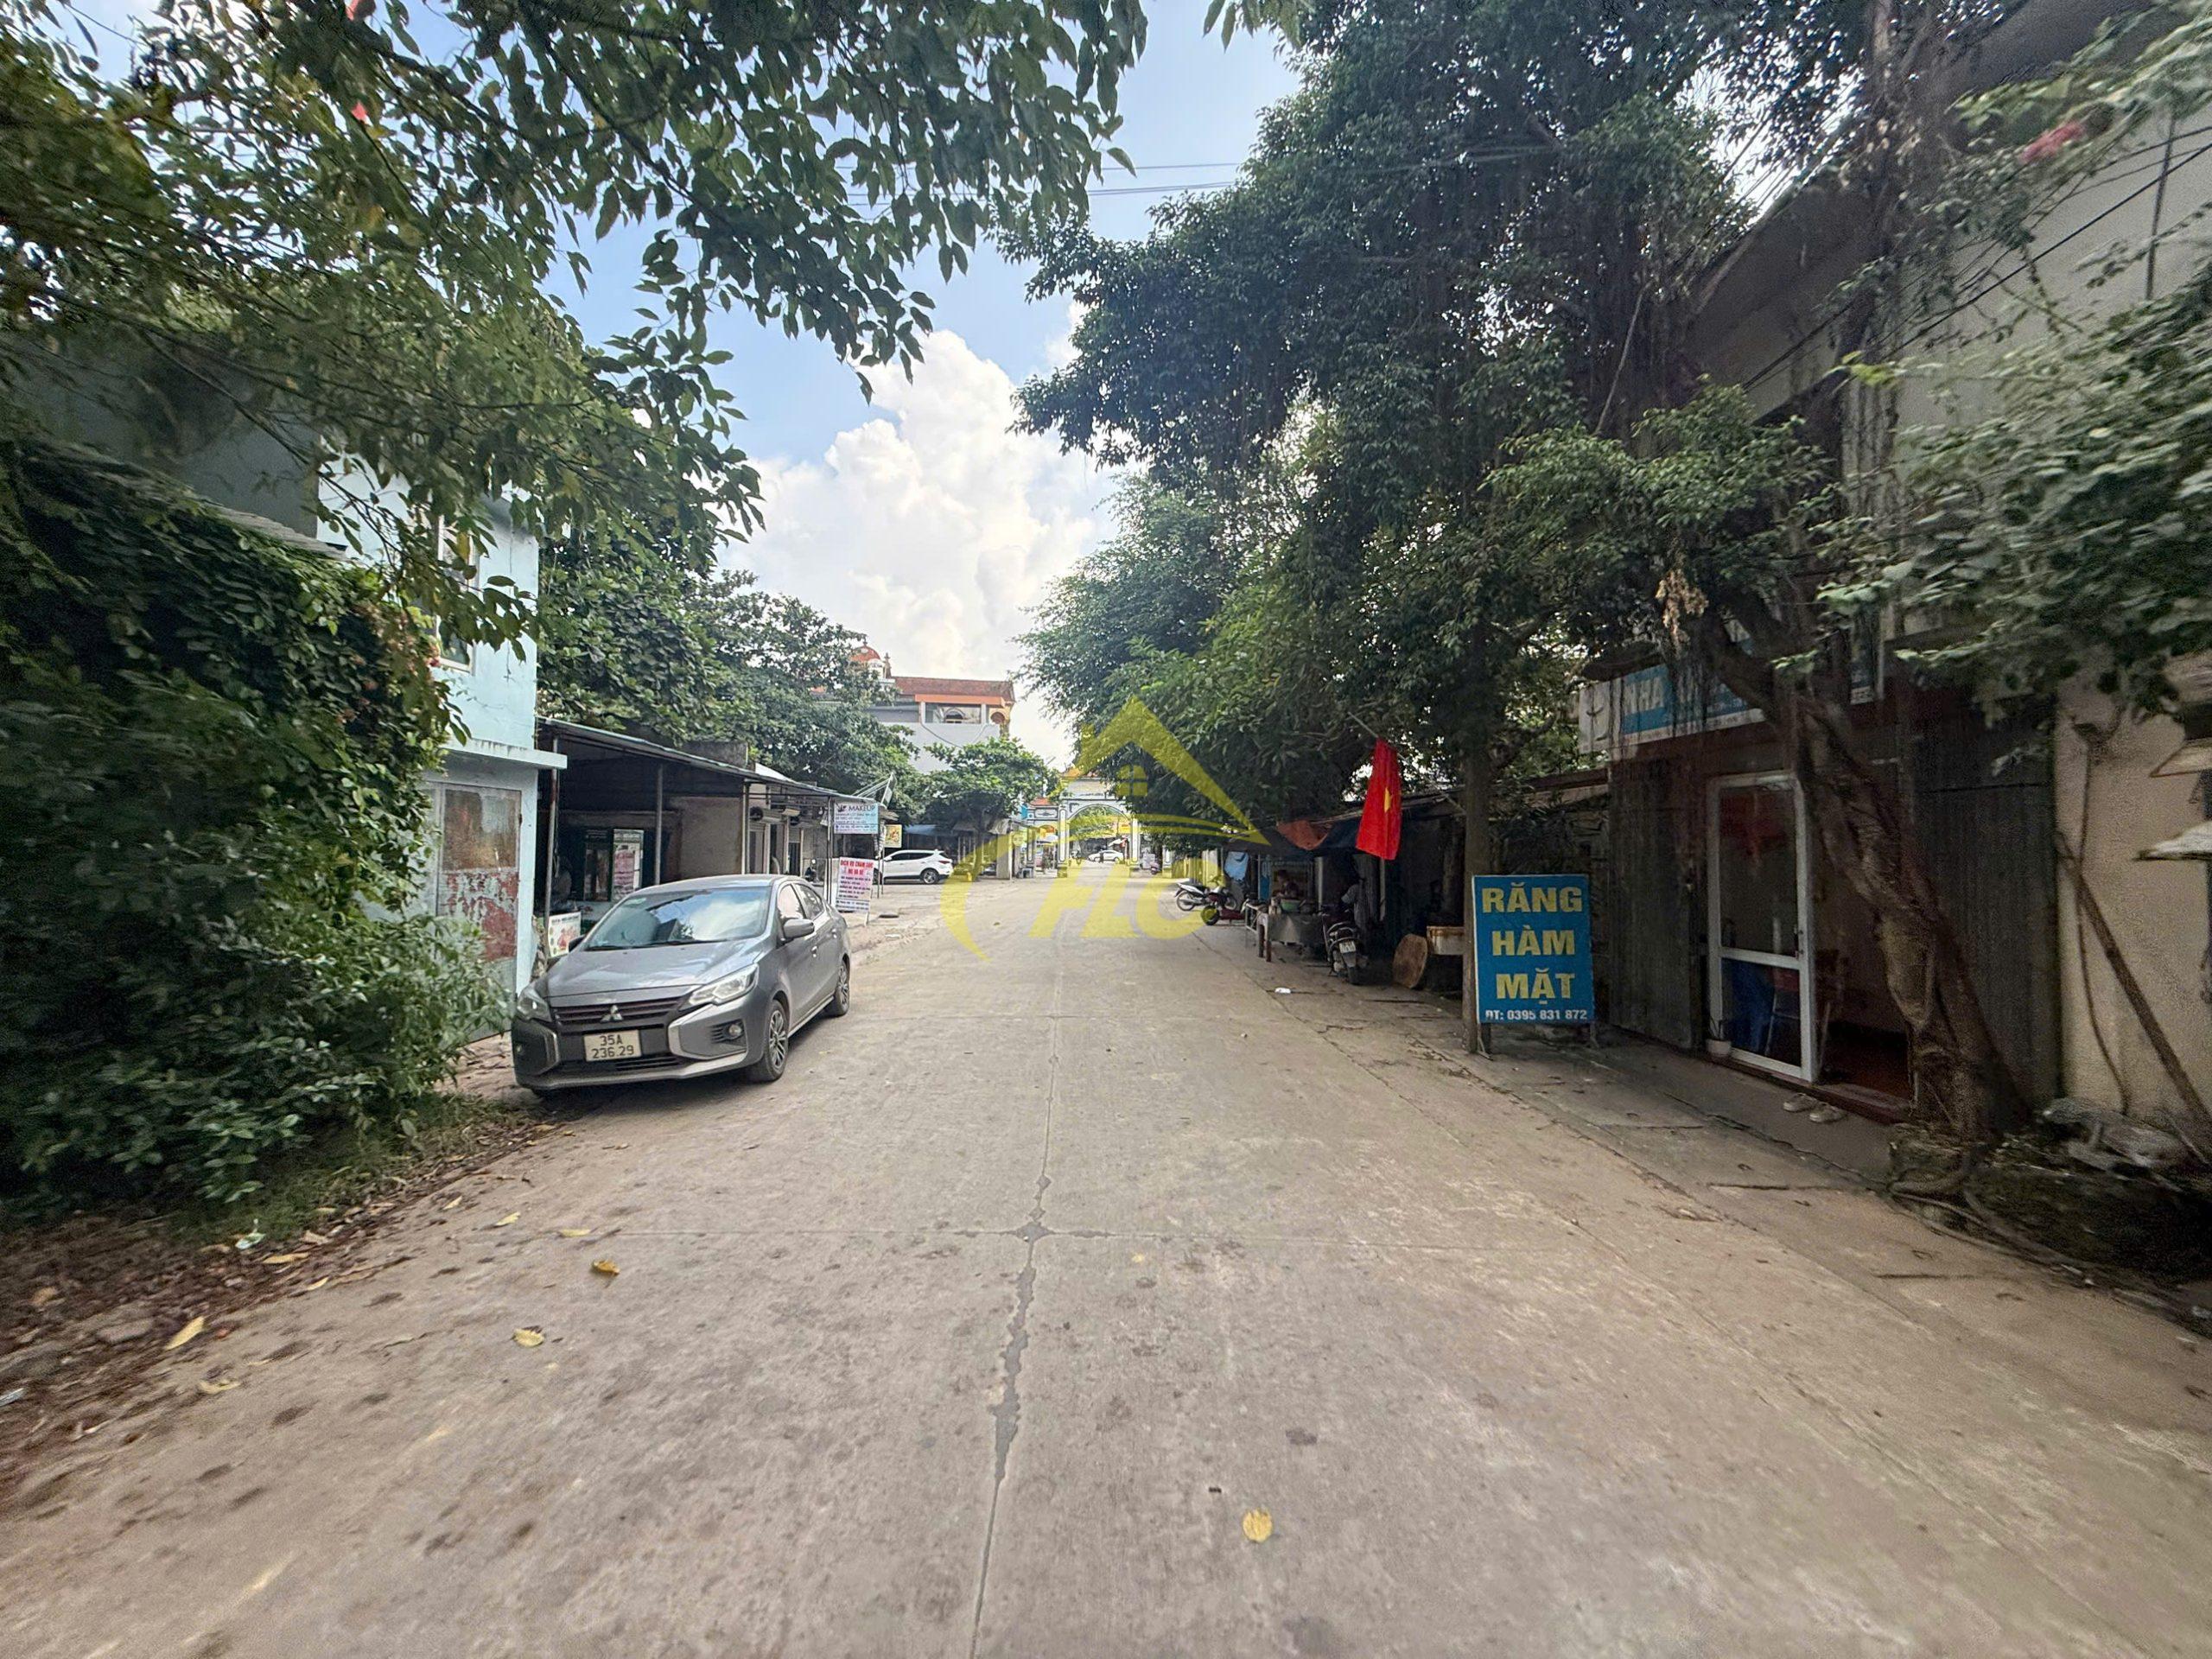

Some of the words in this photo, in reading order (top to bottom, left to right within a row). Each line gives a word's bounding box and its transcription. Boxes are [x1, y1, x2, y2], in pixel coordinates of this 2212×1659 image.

[1482, 881, 1583, 913] RĂNG
[1491, 925, 1575, 957] HÀM
[1496, 968, 1575, 1005] MẶT
[1506, 1009, 1536, 1020] 0395
[1539, 1009, 1560, 1020] 831
[1565, 1008, 1588, 1020] 872
[599, 1033, 624, 1046] 35A
[591, 1045, 635, 1059] 236.29
